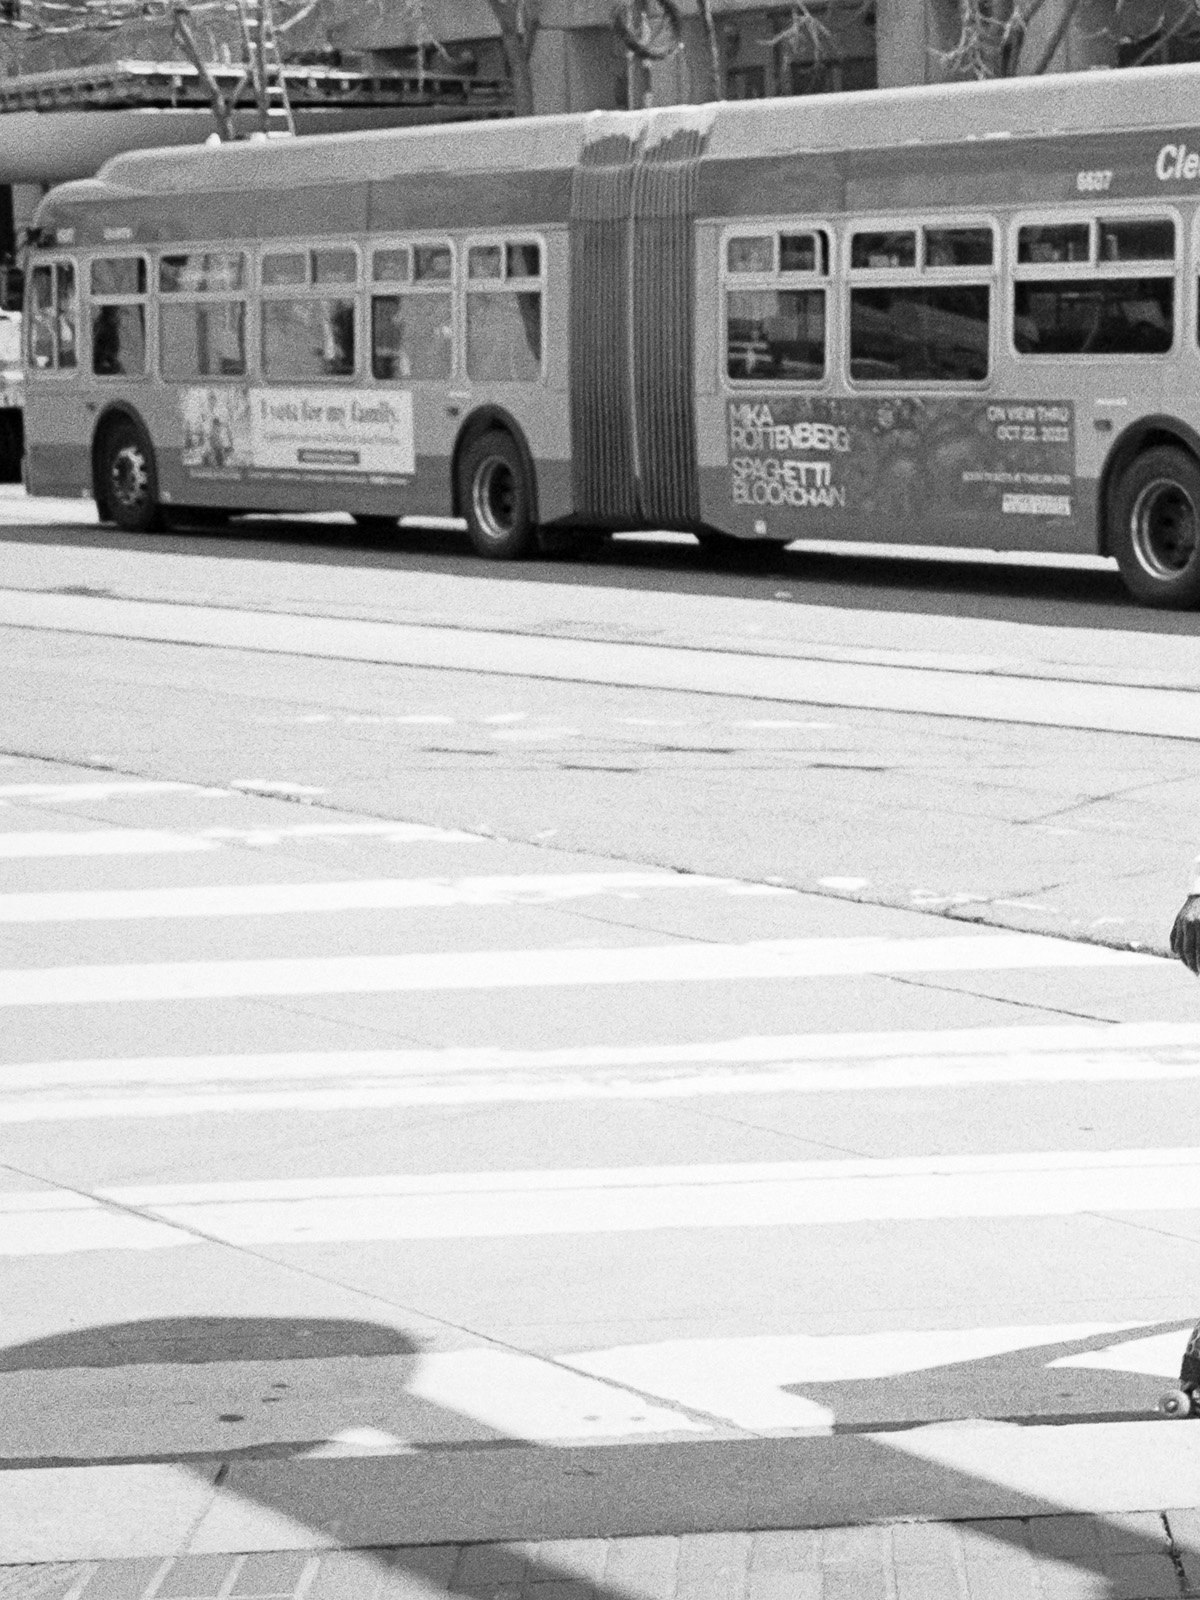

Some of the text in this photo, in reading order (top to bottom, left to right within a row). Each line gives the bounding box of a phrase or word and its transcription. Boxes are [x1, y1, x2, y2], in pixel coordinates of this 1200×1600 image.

[729, 403, 774, 427] MIKA
[730, 421, 851, 452] ROTTENBERG
[731, 456, 832, 488] SPAGHETTI
